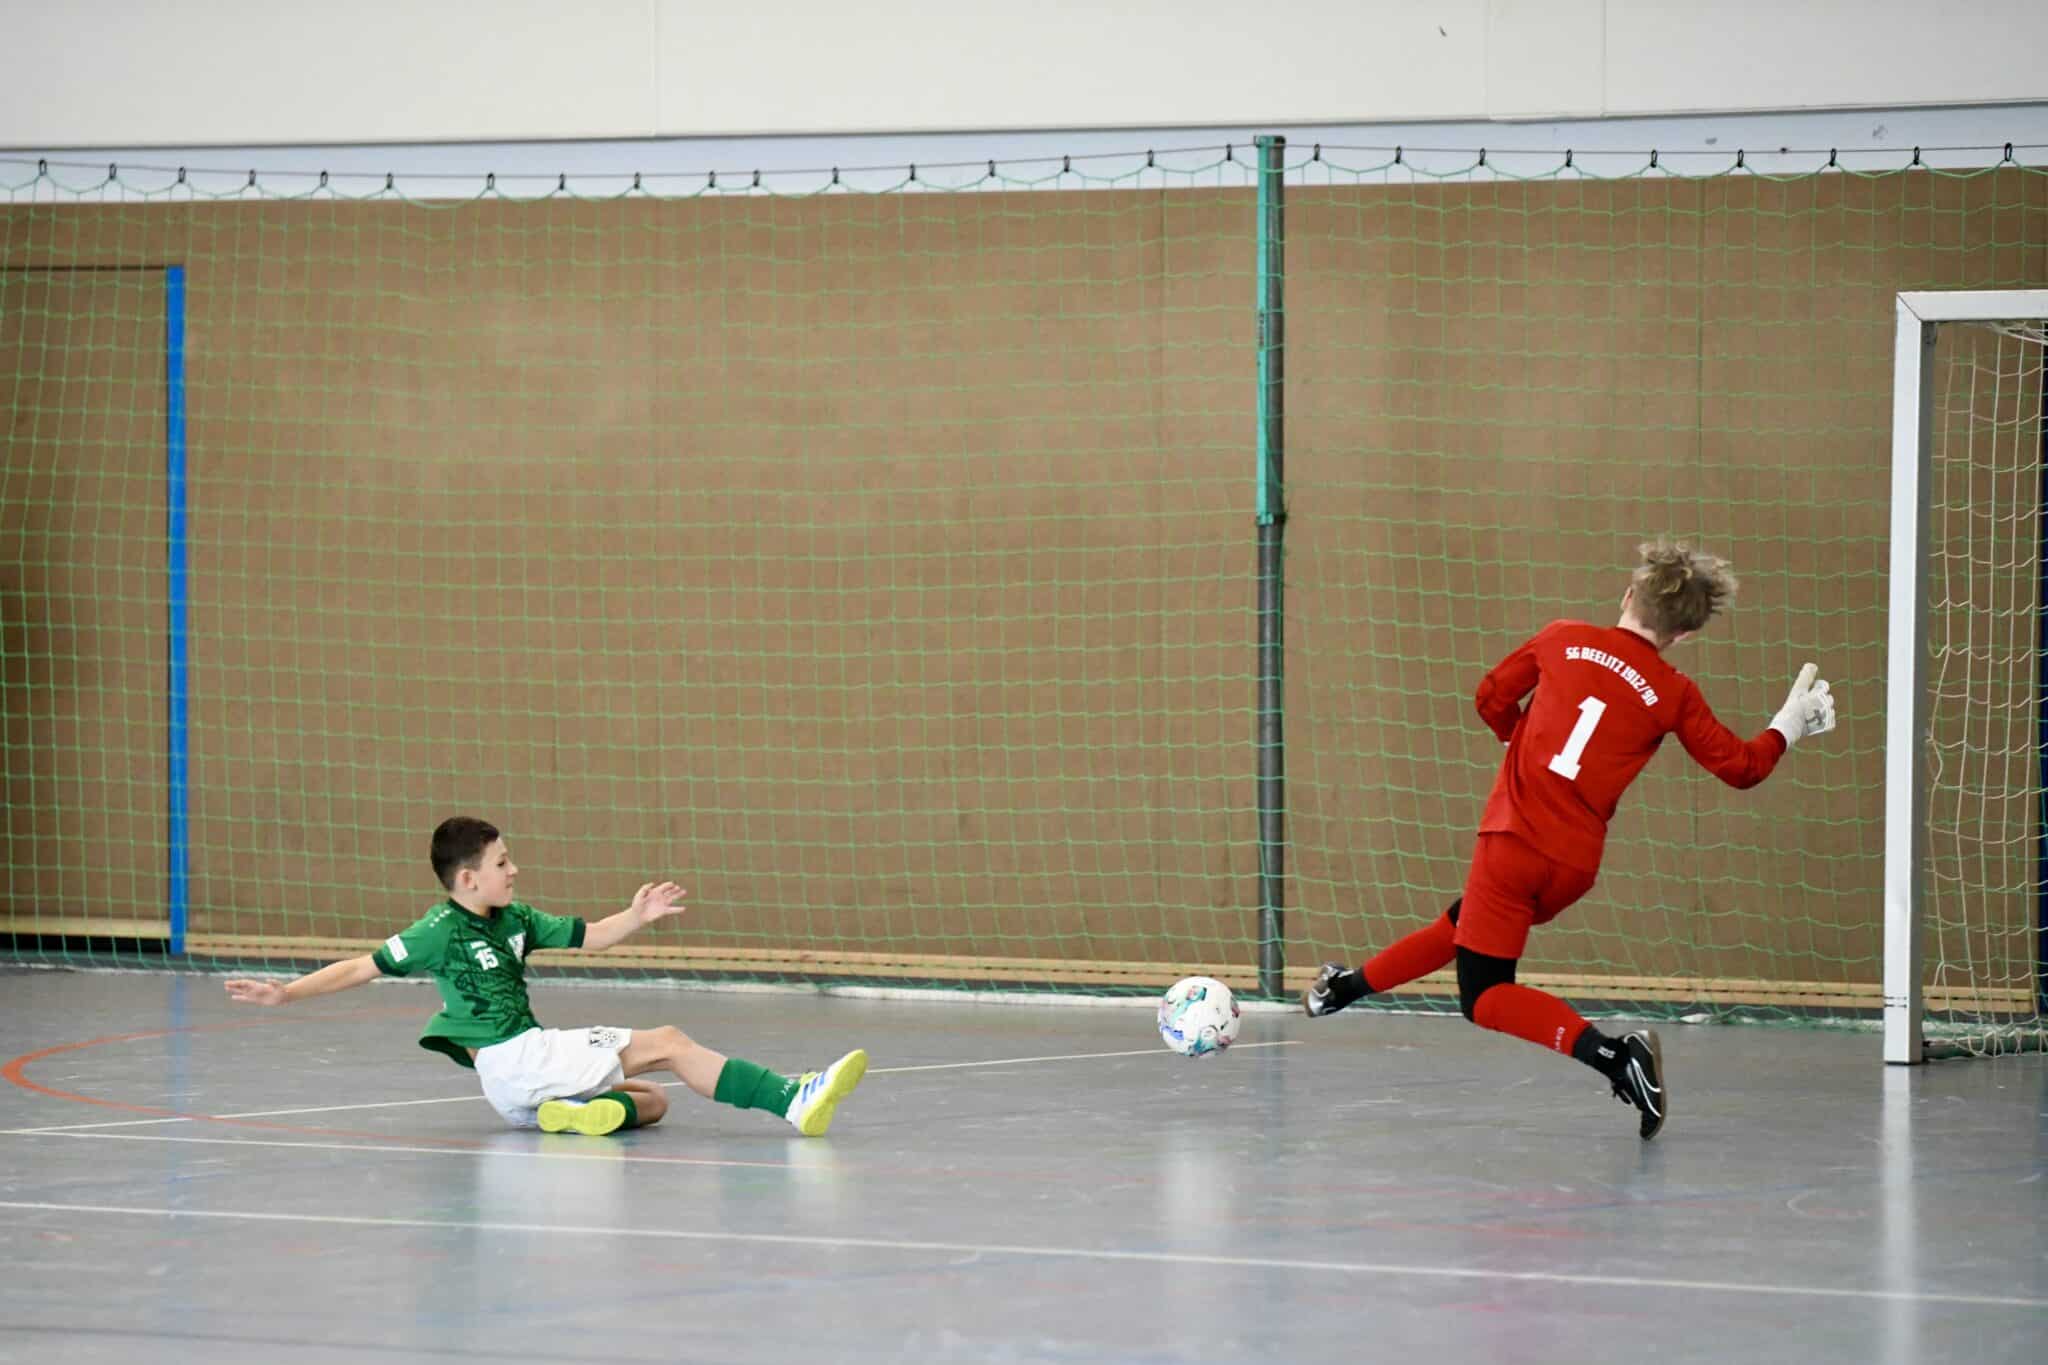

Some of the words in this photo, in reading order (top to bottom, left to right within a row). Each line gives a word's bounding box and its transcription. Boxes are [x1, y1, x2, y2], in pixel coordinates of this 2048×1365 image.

[1565, 646, 1580, 660] SG
[1581, 646, 1625, 673] BEELITZ
[1620, 665, 1659, 706] 1912/90
[1548, 696, 1607, 780] 1
[475, 946, 499, 970] 15
